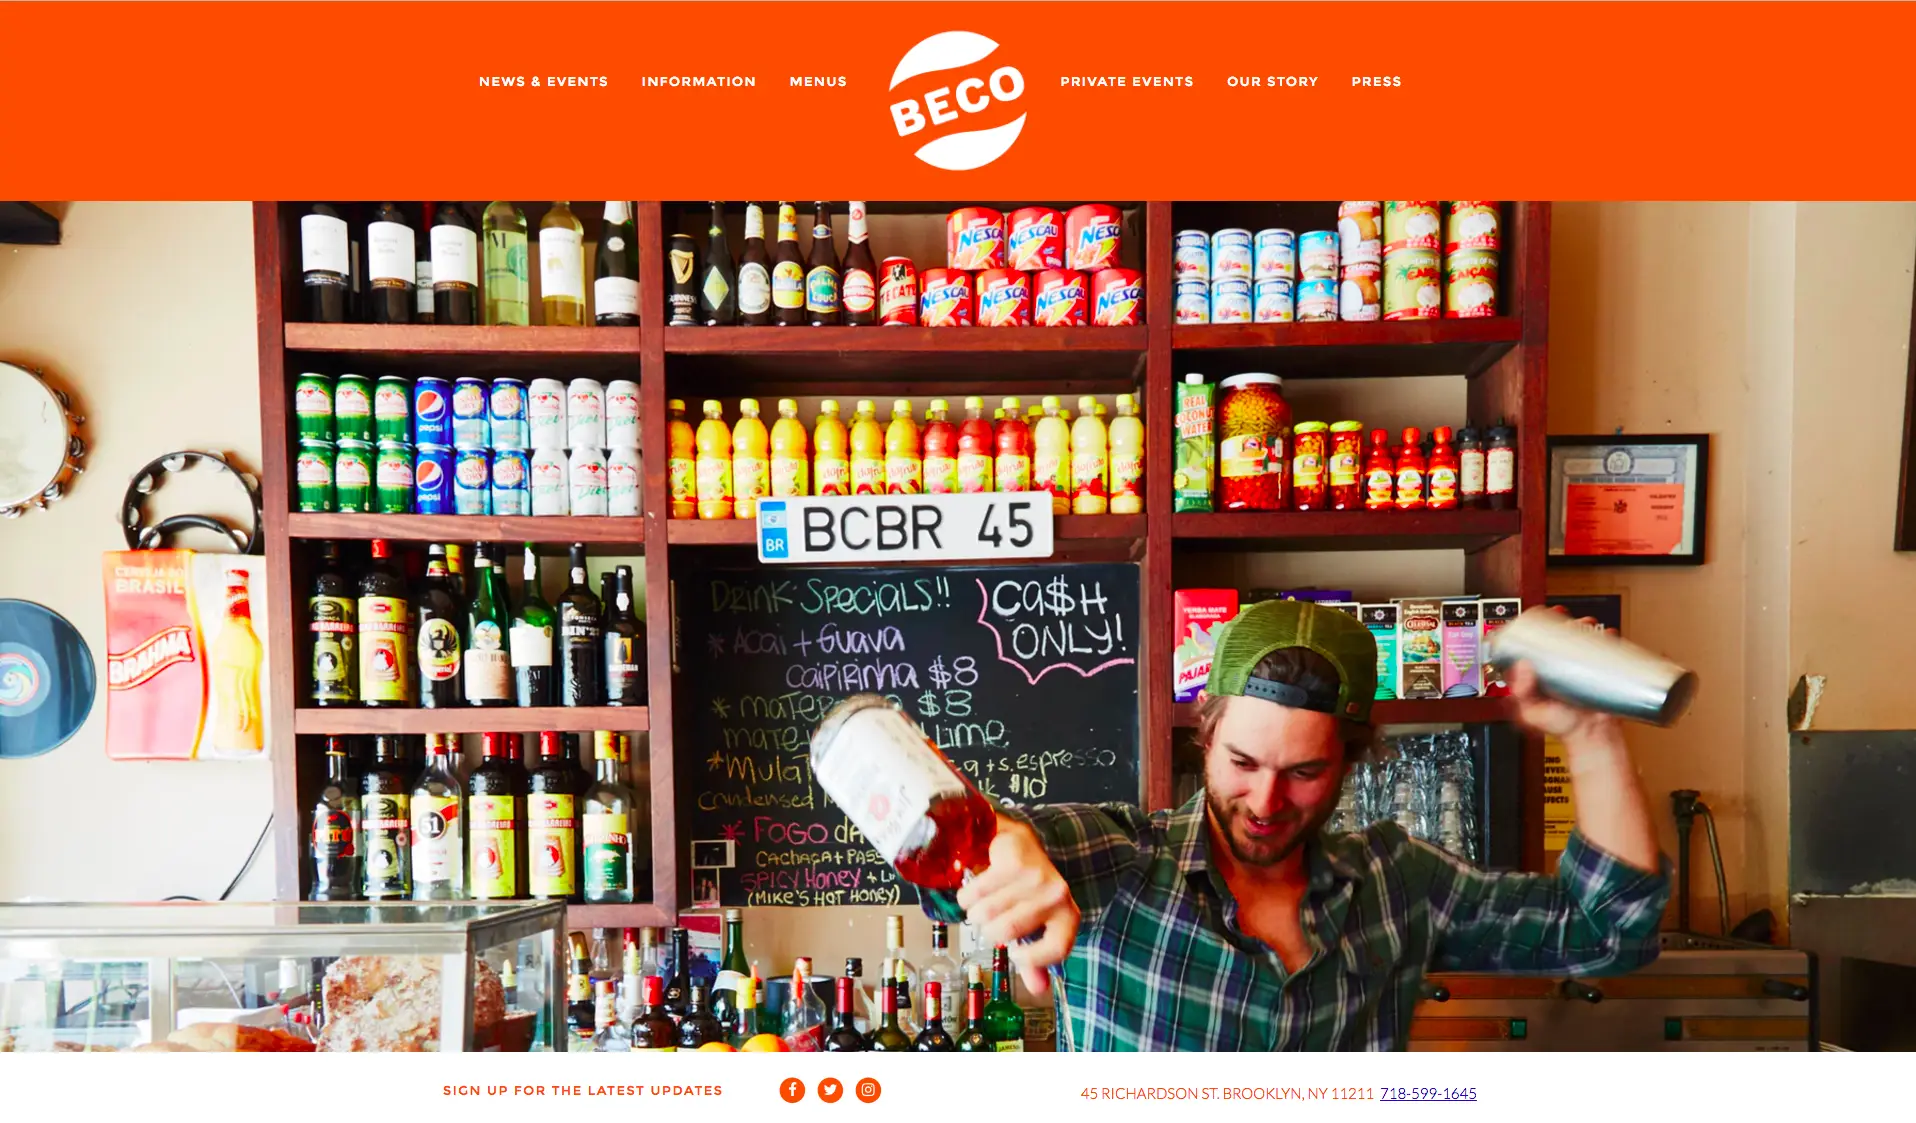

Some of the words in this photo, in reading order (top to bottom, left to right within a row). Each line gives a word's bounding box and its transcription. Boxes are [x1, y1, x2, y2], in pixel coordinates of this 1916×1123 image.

[803, 505, 943, 552] BCBR
[977, 502, 1034, 549] 45
[765, 539, 785, 552] BR
[115, 578, 185, 595] BRASIL
[108, 630, 190, 684] BRAHMA
[928, 654, 979, 691] $8
[420, 816, 441, 836] 51
